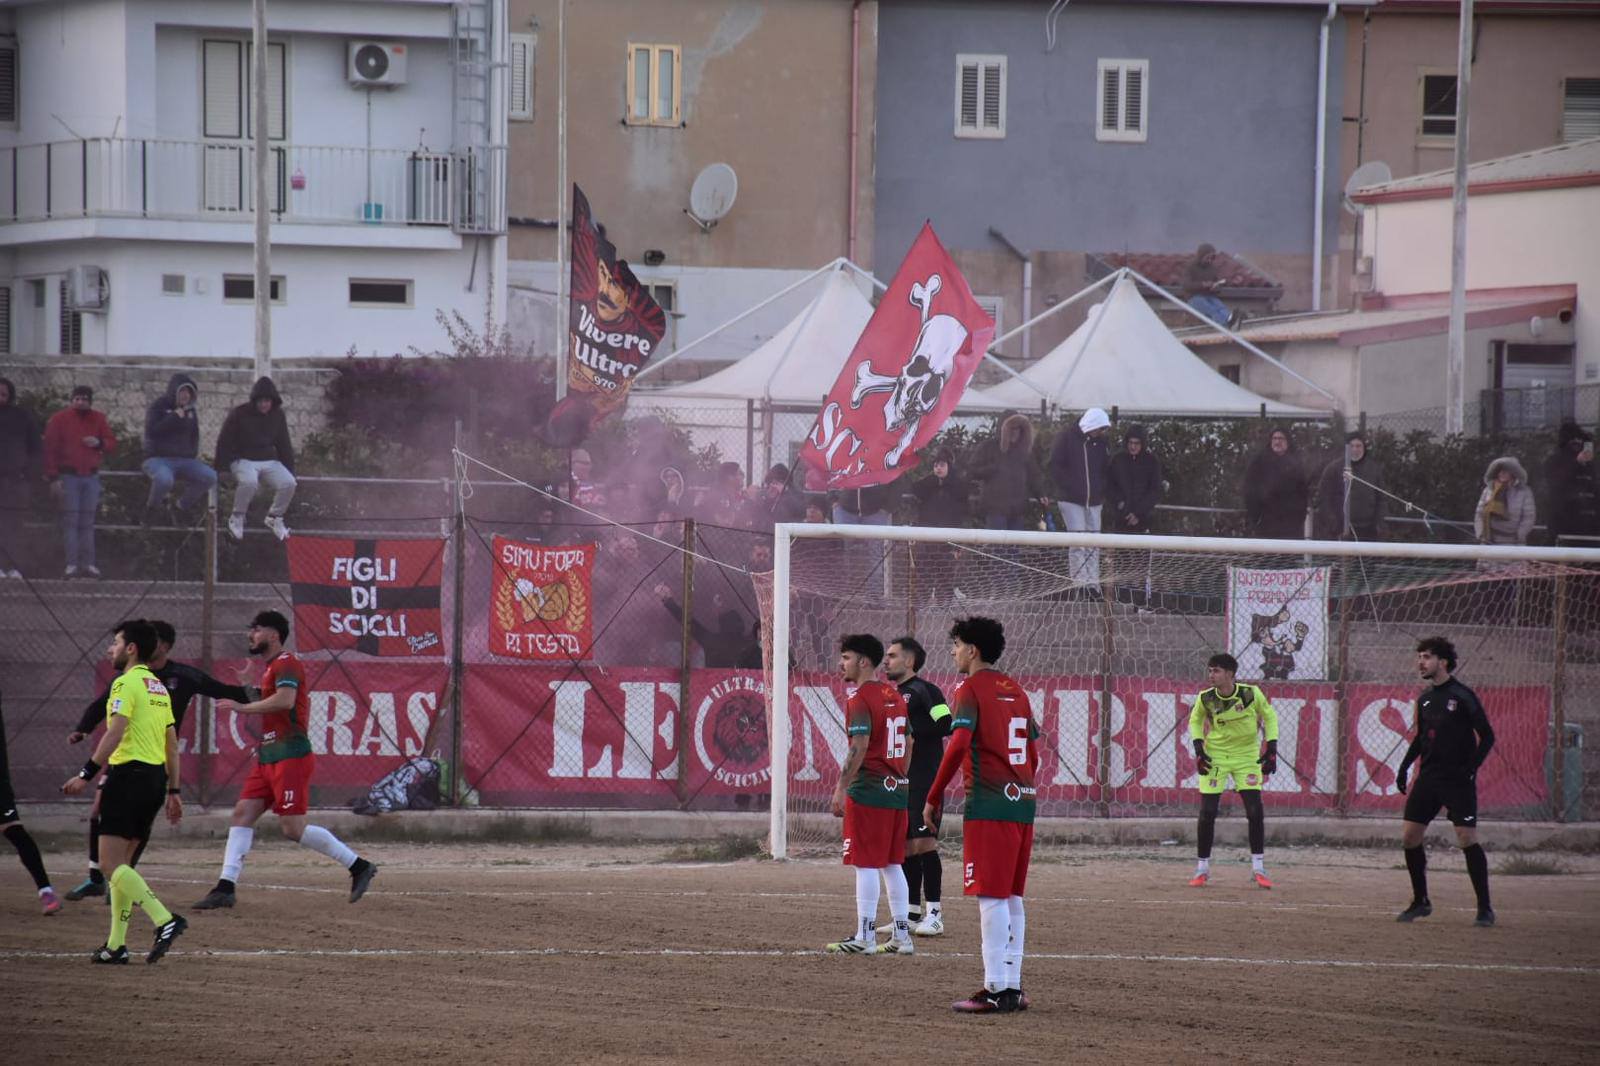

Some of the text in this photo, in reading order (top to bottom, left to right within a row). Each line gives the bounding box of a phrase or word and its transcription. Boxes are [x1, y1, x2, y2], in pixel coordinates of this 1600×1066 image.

[579, 305, 650, 355] Vivere
[503, 544, 540, 569] SIMU
[331, 557, 396, 581] FIGLI
[351, 586, 377, 609] DI
[328, 612, 406, 636] SCICLI
[710, 676, 773, 699] ULTRA
[1008, 717, 1027, 765] 5
